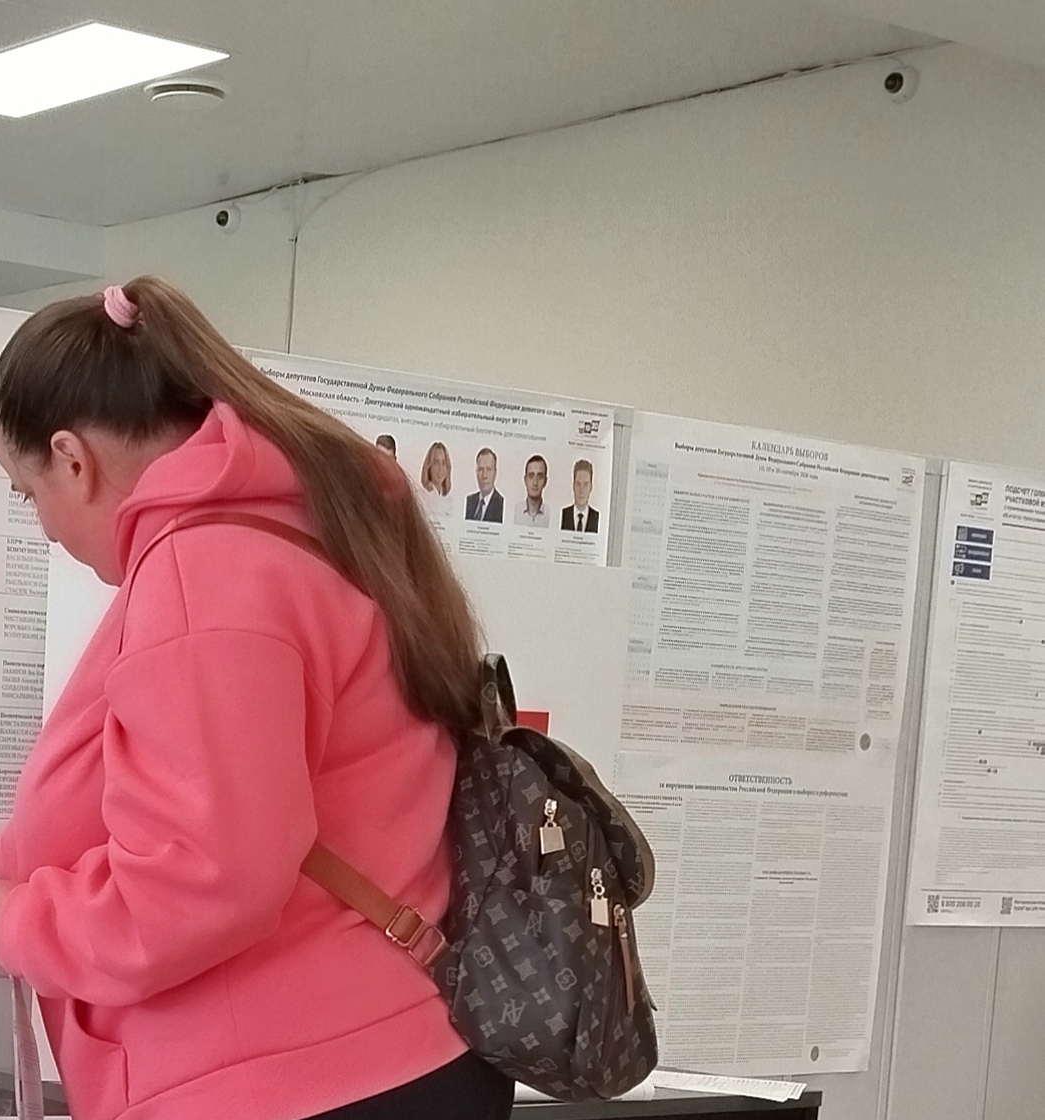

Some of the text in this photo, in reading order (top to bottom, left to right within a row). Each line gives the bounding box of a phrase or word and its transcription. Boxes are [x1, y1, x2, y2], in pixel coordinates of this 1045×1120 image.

[285, 371, 316, 383] депутатов
[317, 376, 368, 390] Государственной
[368, 383, 385, 392] Думы
[387, 386, 428, 400] Федерального
[429, 391, 456, 402] Собрания
[457, 395, 489, 407] Российской
[300, 388, 336, 399] Московская
[336, 393, 360, 403] область
[365, 397, 403, 410] Дмитровский
[405, 402, 451, 416] одномандатный
[451, 409, 494, 422] избирательный
[495, 415, 511, 425] округ
[751, 440, 829, 461] КАЛЕНДАРЬ ВЫБОРОВ
[728, 774, 792, 785] ОТВЕТСТВЕННОСТЬ
